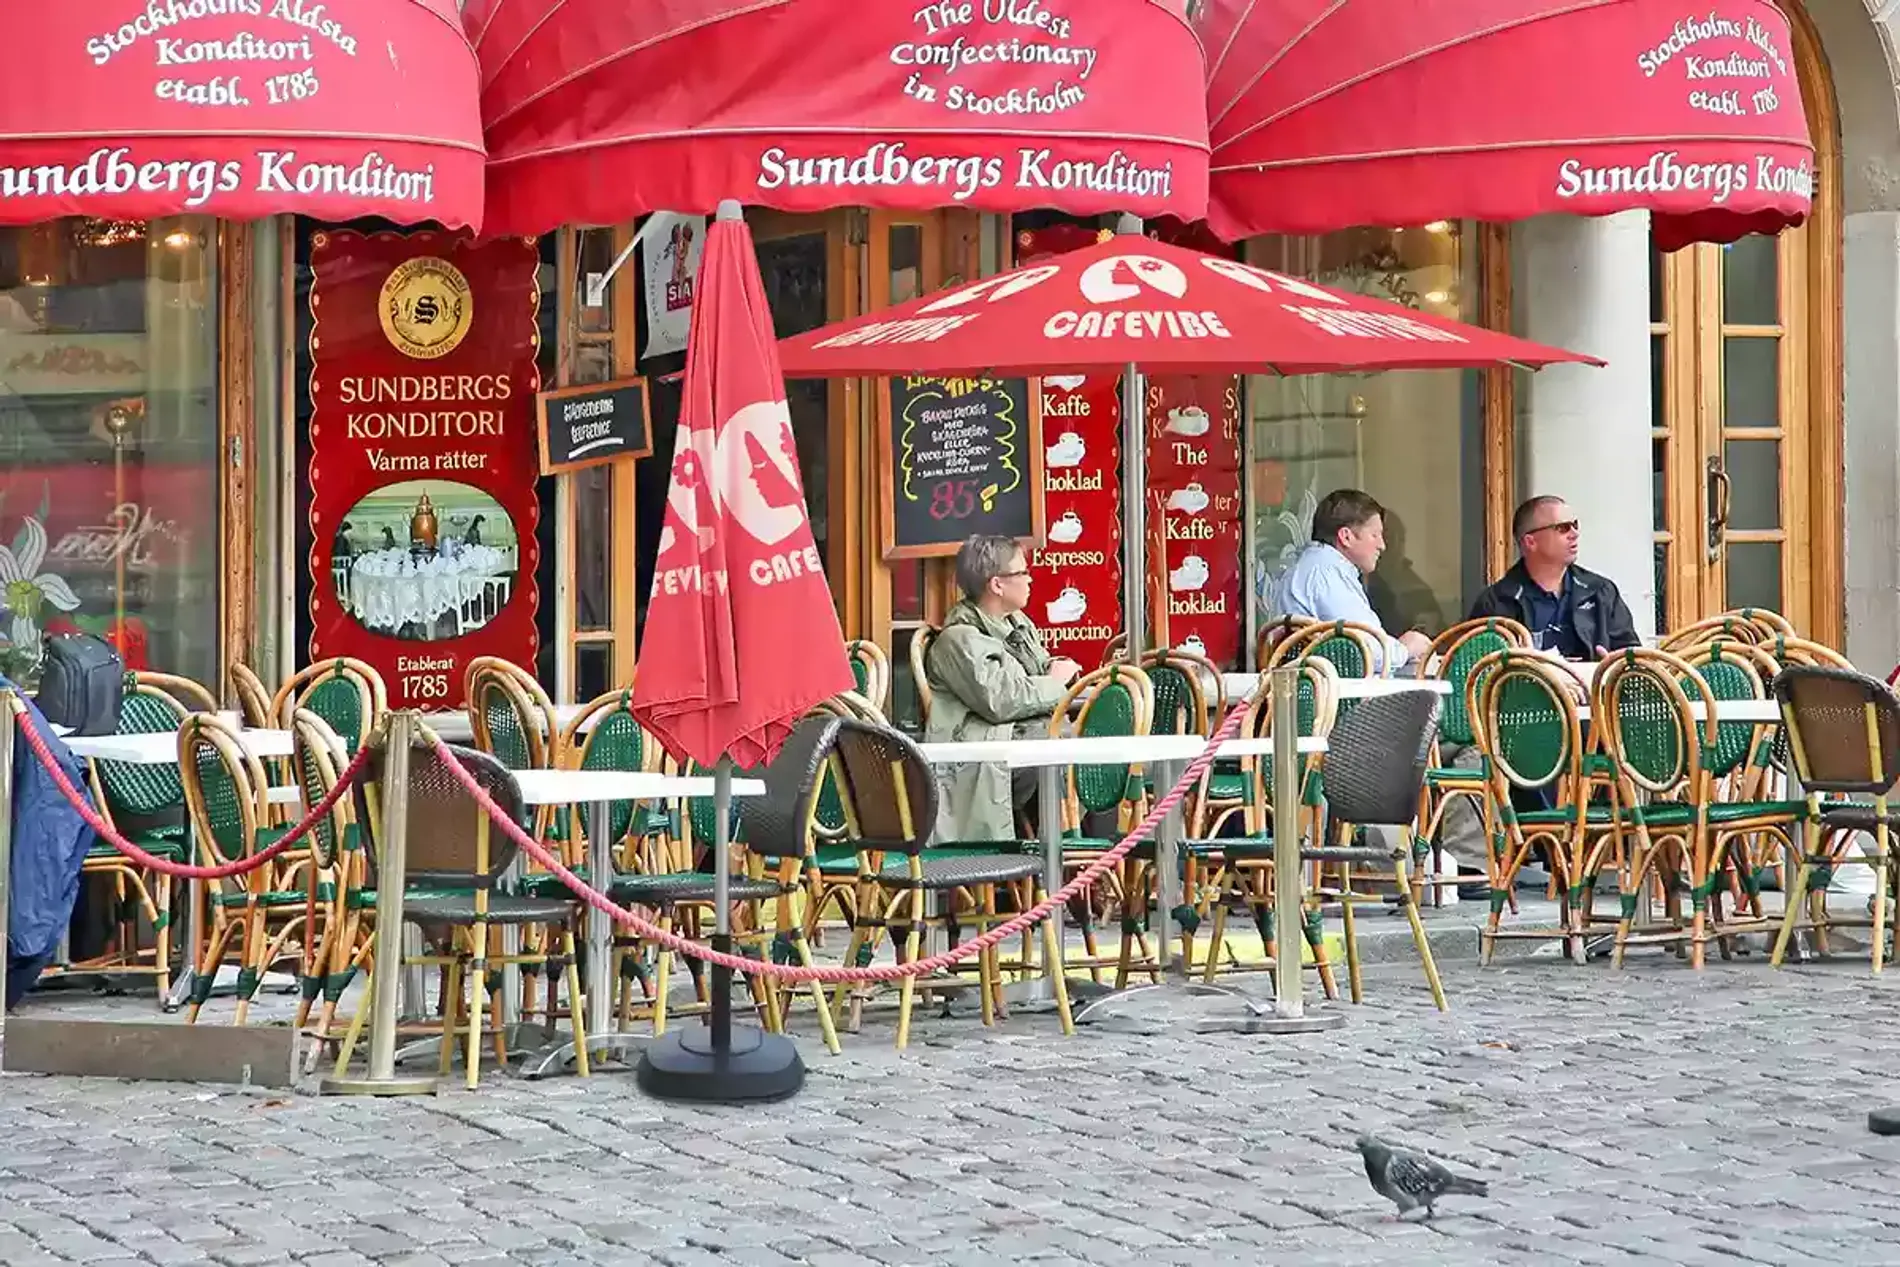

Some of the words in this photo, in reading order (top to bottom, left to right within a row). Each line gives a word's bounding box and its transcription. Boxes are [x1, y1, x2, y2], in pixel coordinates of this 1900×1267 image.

[914, 2, 973, 37] The
[155, 32, 314, 66] Konditori
[889, 37, 1098, 80] Confectionary
[1637, 12, 1741, 78] Stockholms
[1685, 51, 1771, 79] Konditori
[154, 76, 249, 107] etabl.
[265, 67, 320, 105] 1785
[903, 72, 936, 103] in
[945, 81, 1086, 115] Stockholm
[1689, 90, 1746, 115] etabl.
[0, 148, 241, 206] undbergs
[256, 151, 435, 203] Konditori
[757, 143, 1003, 201] Sundbergs
[1015, 148, 1173, 199] Konditori
[1555, 152, 1748, 203] Sundbergs
[1043, 310, 1233, 339] CAFEVIBE
[339, 374, 511, 404] SUNDBERGS
[1042, 394, 1091, 417] Kaffe
[346, 410, 505, 439] KONDITORI
[366, 448, 430, 471] Varma
[435, 452, 488, 469] rätter
[1045, 468, 1103, 491] hoklad
[1165, 517, 1215, 540] Kaffe
[750, 546, 822, 586] CAFE
[1031, 547, 1105, 575] Espresso
[1168, 592, 1226, 615] hoklad
[1036, 618, 1113, 649] appuccino
[397, 656, 454, 672] Etablerat
[401, 674, 449, 699] 1785
